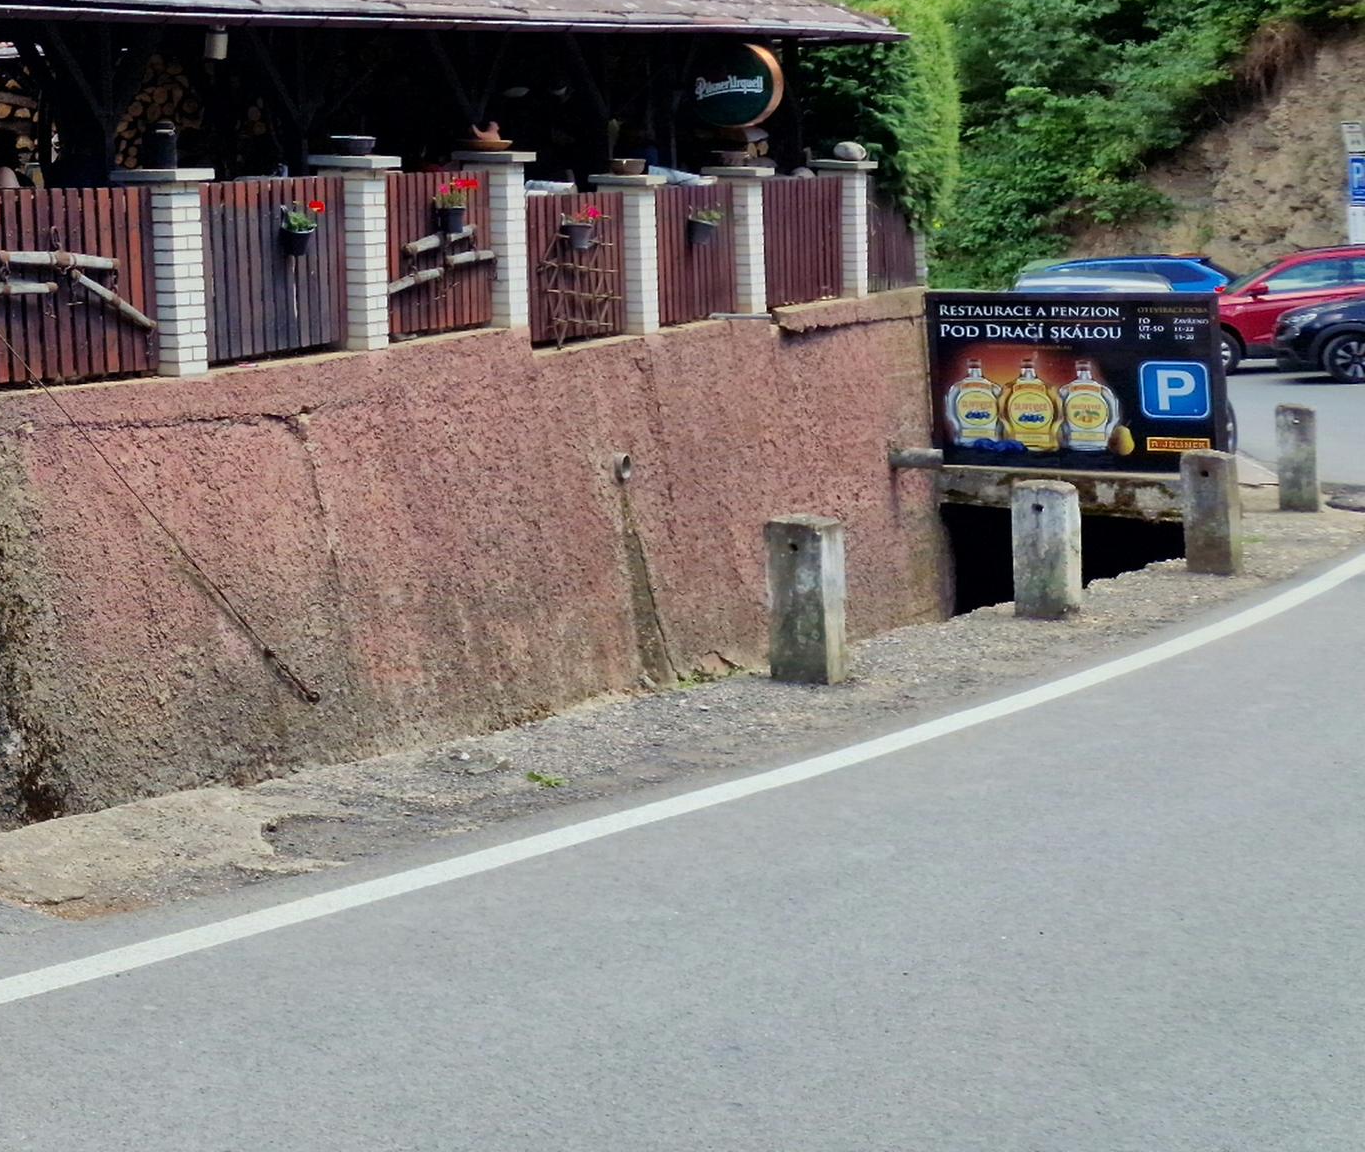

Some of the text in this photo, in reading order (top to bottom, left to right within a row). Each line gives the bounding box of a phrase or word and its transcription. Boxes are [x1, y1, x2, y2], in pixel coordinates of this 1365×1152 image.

[939, 304, 1120, 317] RESTAURACE A PENZION
[940, 323, 1121, 339] POD DRAČÍ SKÁLOU
[1156, 370, 1196, 410] P
